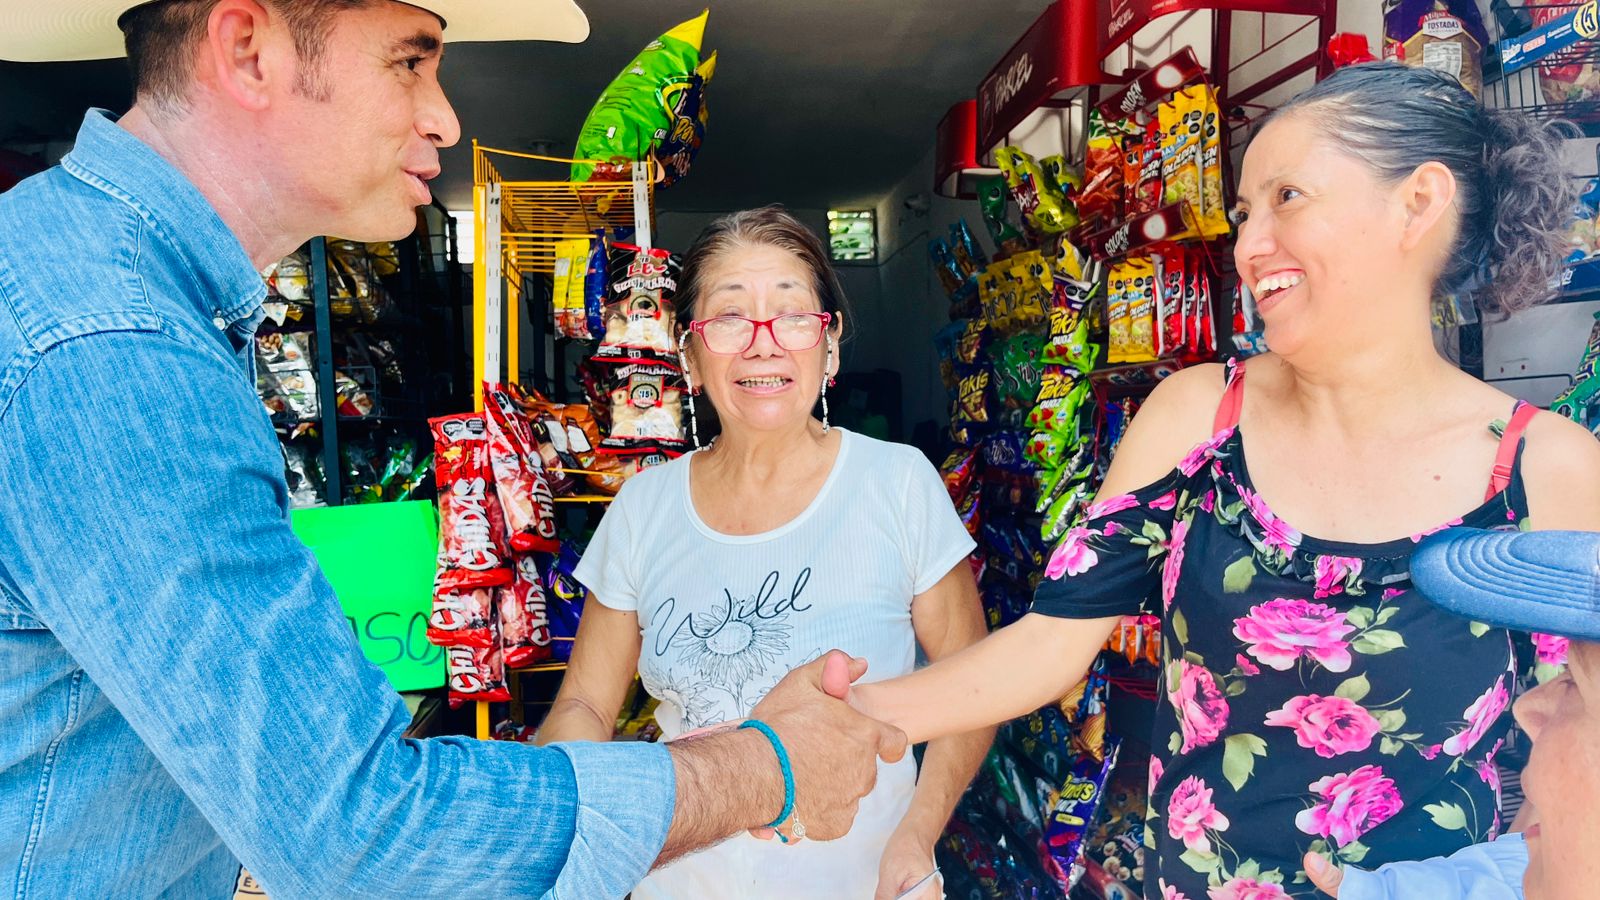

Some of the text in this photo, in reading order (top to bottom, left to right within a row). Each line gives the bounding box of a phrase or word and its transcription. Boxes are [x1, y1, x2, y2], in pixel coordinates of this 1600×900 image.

[1427, 21, 1460, 29] TOSTADAS
[1120, 79, 1142, 113] GOLDEN
[1105, 222, 1130, 257] GOLDEN
[958, 369, 990, 402] Takis
[1035, 376, 1075, 403] Takis
[452, 477, 498, 571] CHIDAS
[519, 556, 551, 646] CHIDAS
[651, 567, 813, 657] Wild
